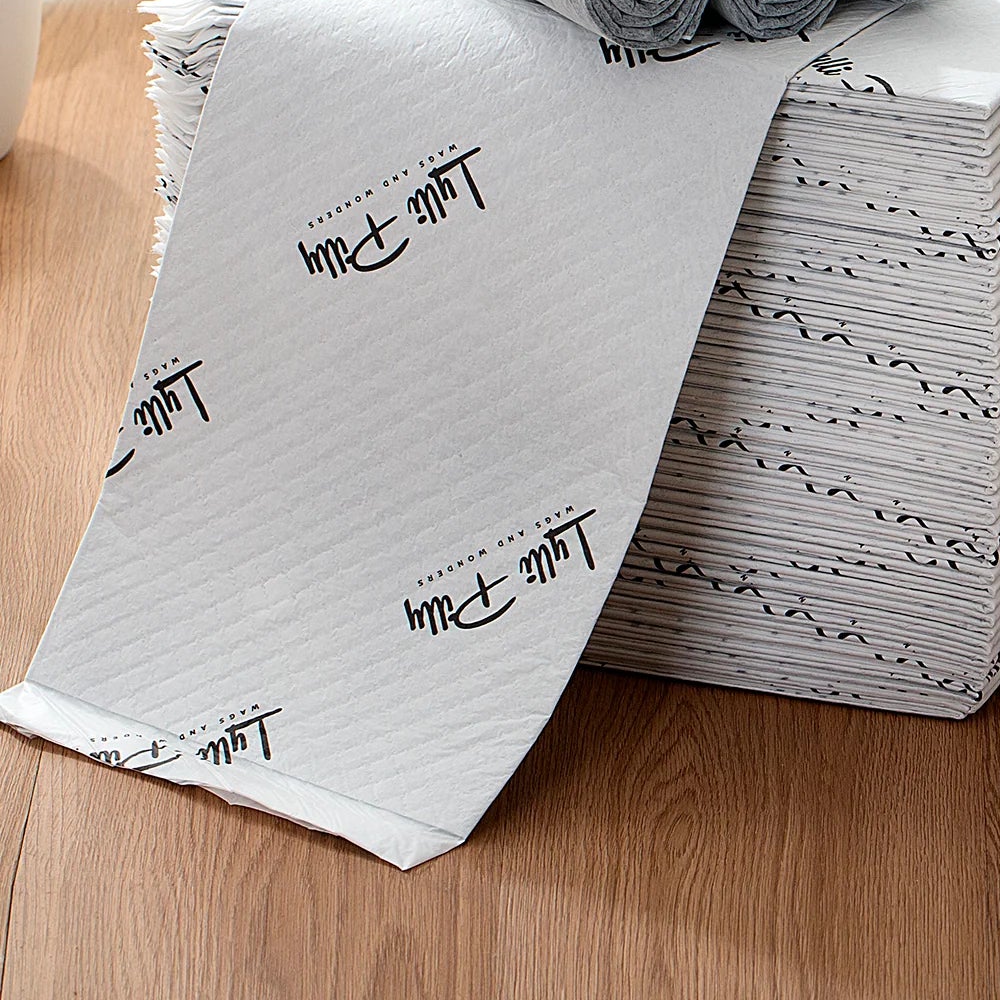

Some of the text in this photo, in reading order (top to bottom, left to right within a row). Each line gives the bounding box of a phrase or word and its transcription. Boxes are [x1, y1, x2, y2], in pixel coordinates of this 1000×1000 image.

[298, 146, 486, 280] Lylli Pilly
[307, 143, 457, 230] WAGS AND WONDERS
[133, 360, 210, 436] Lylli
[143, 357, 180, 381] WAGS
[403, 508, 597, 636] Lylli Pilly
[417, 505, 575, 588] WAGS AND WONDERS
[179, 724, 208, 741] AND
[218, 703, 260, 725] WAGS
